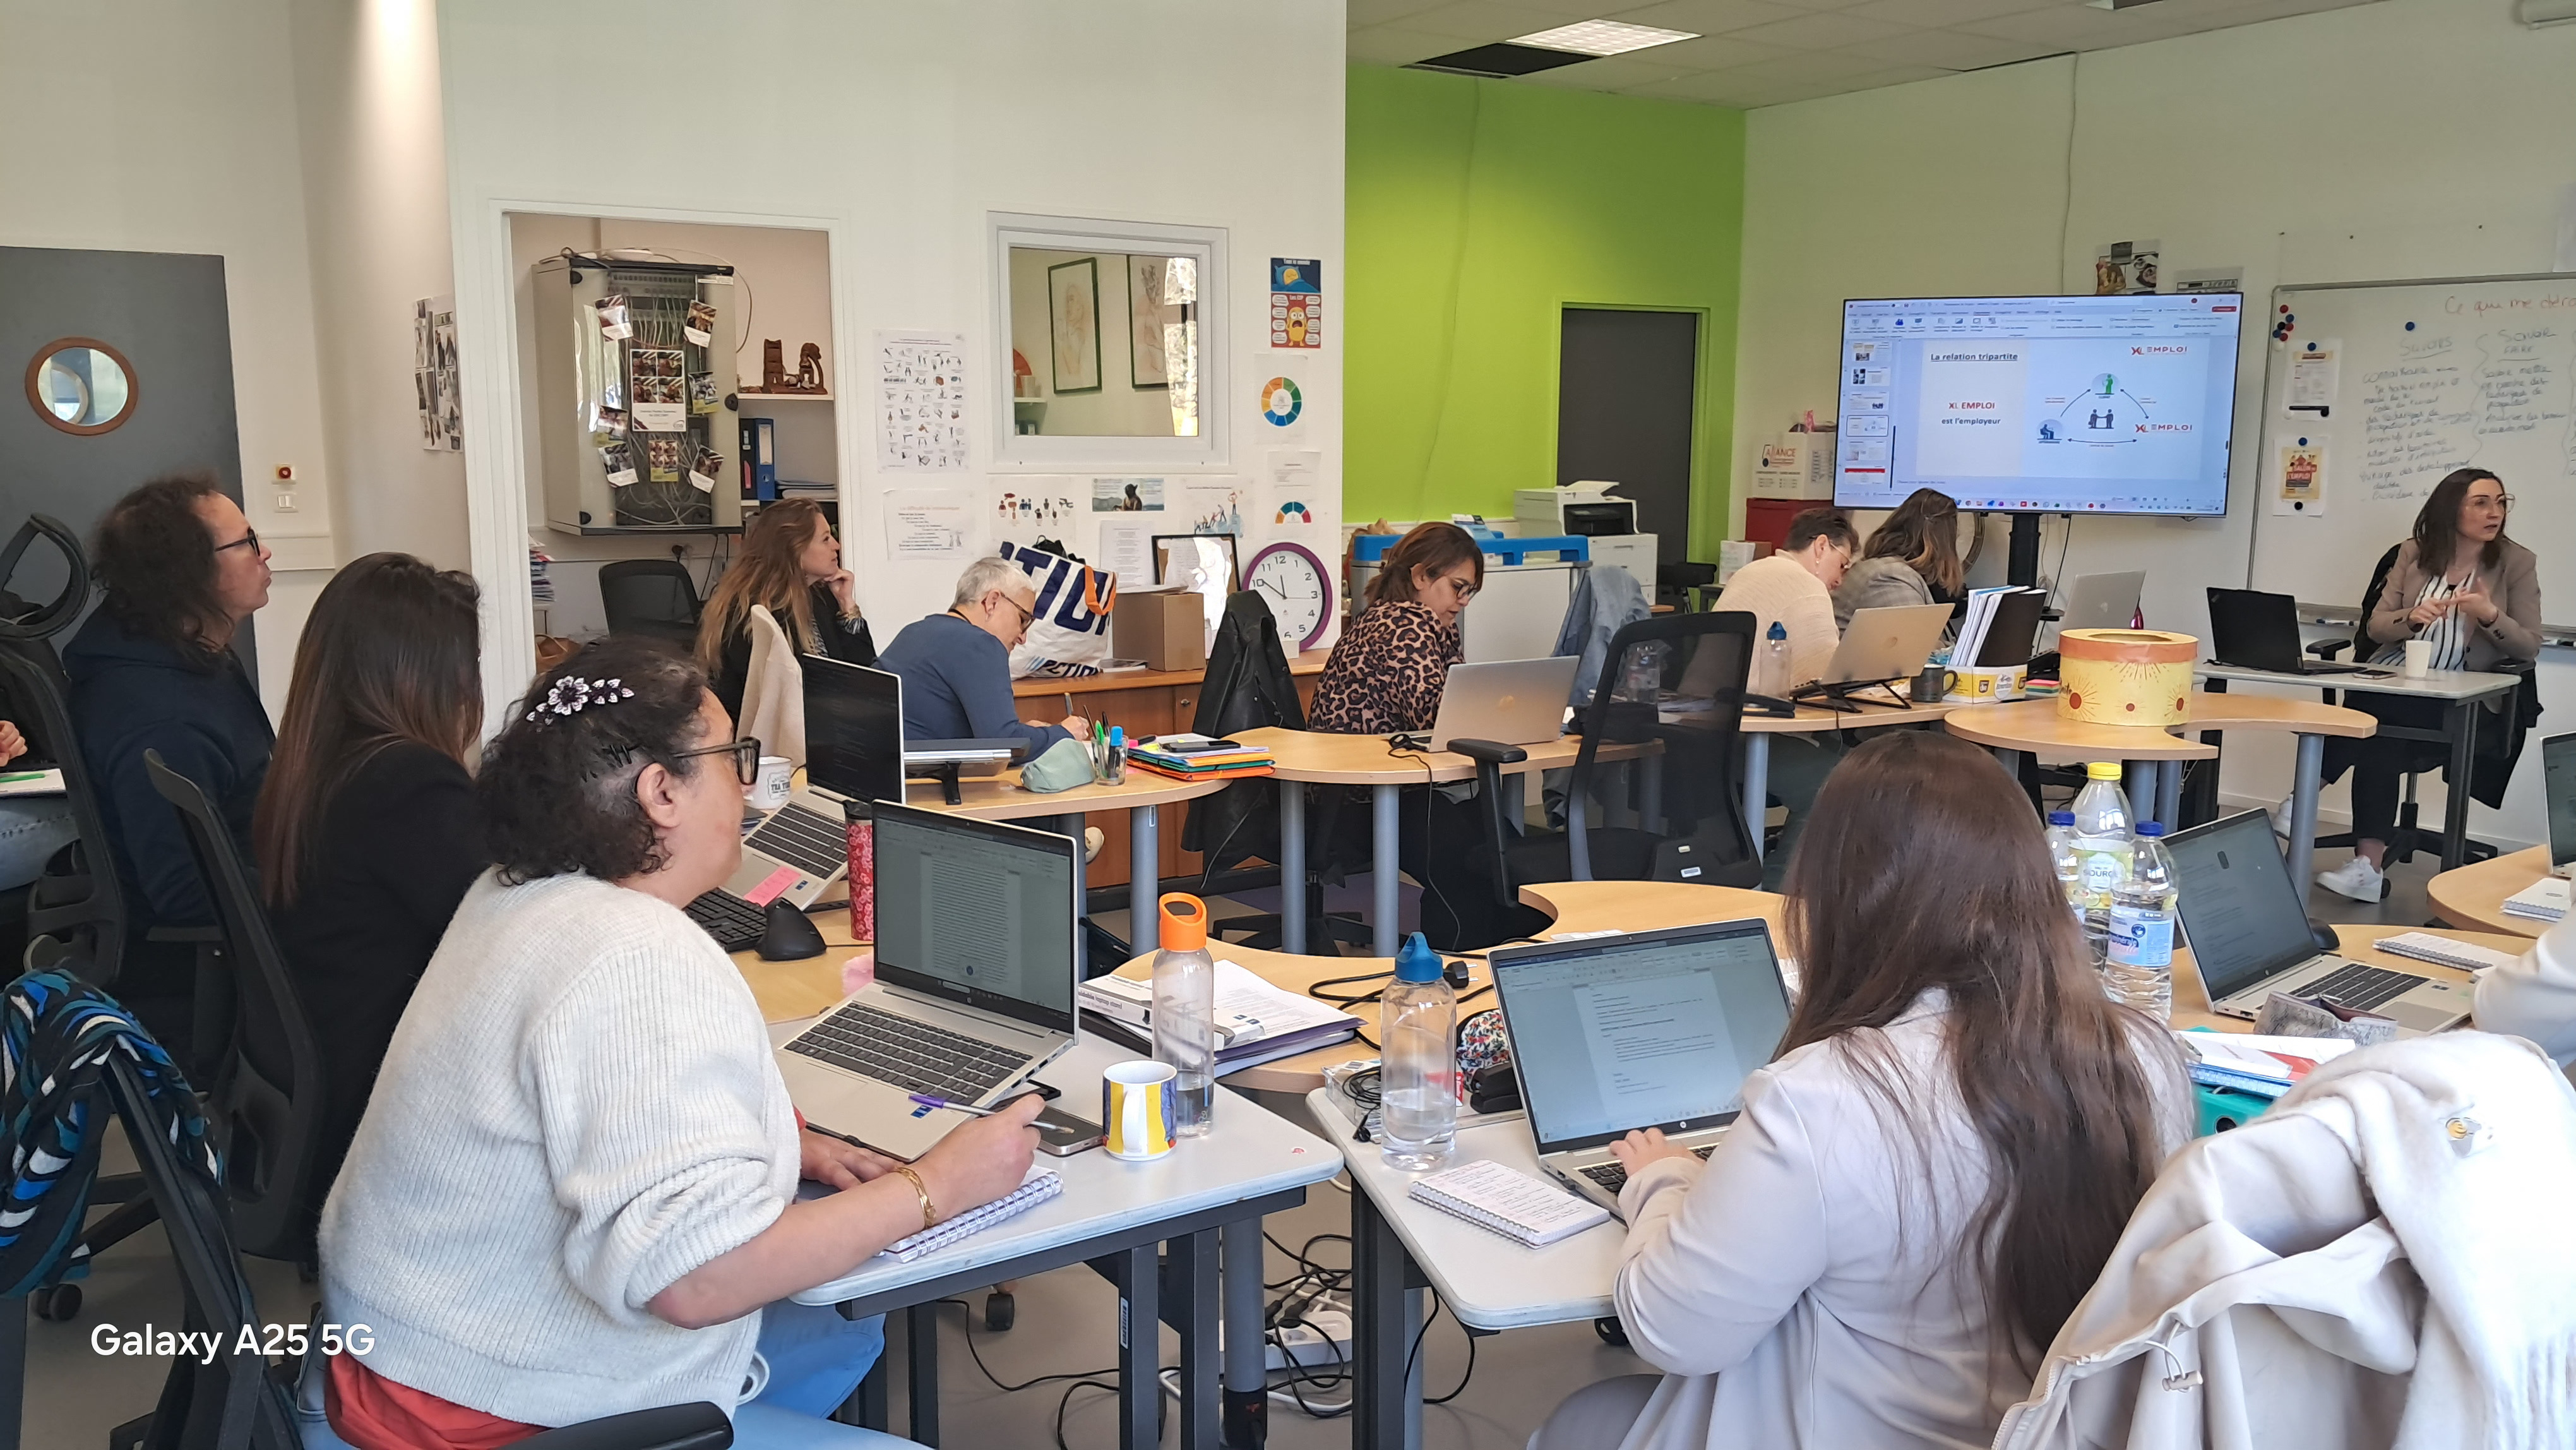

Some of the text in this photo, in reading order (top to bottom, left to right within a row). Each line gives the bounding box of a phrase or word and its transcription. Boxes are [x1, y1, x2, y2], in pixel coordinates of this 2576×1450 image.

[1979, 353, 2018, 361] tripartite
[1955, 417, 2001, 426] l'employeur
[1274, 556, 1286, 565] 12
[1294, 560, 1298, 568] 1
[1261, 563, 1271, 572] 11
[1252, 578, 1264, 587] 10
[1311, 590, 1318, 599] 3
[1308, 609, 1315, 617] 4
